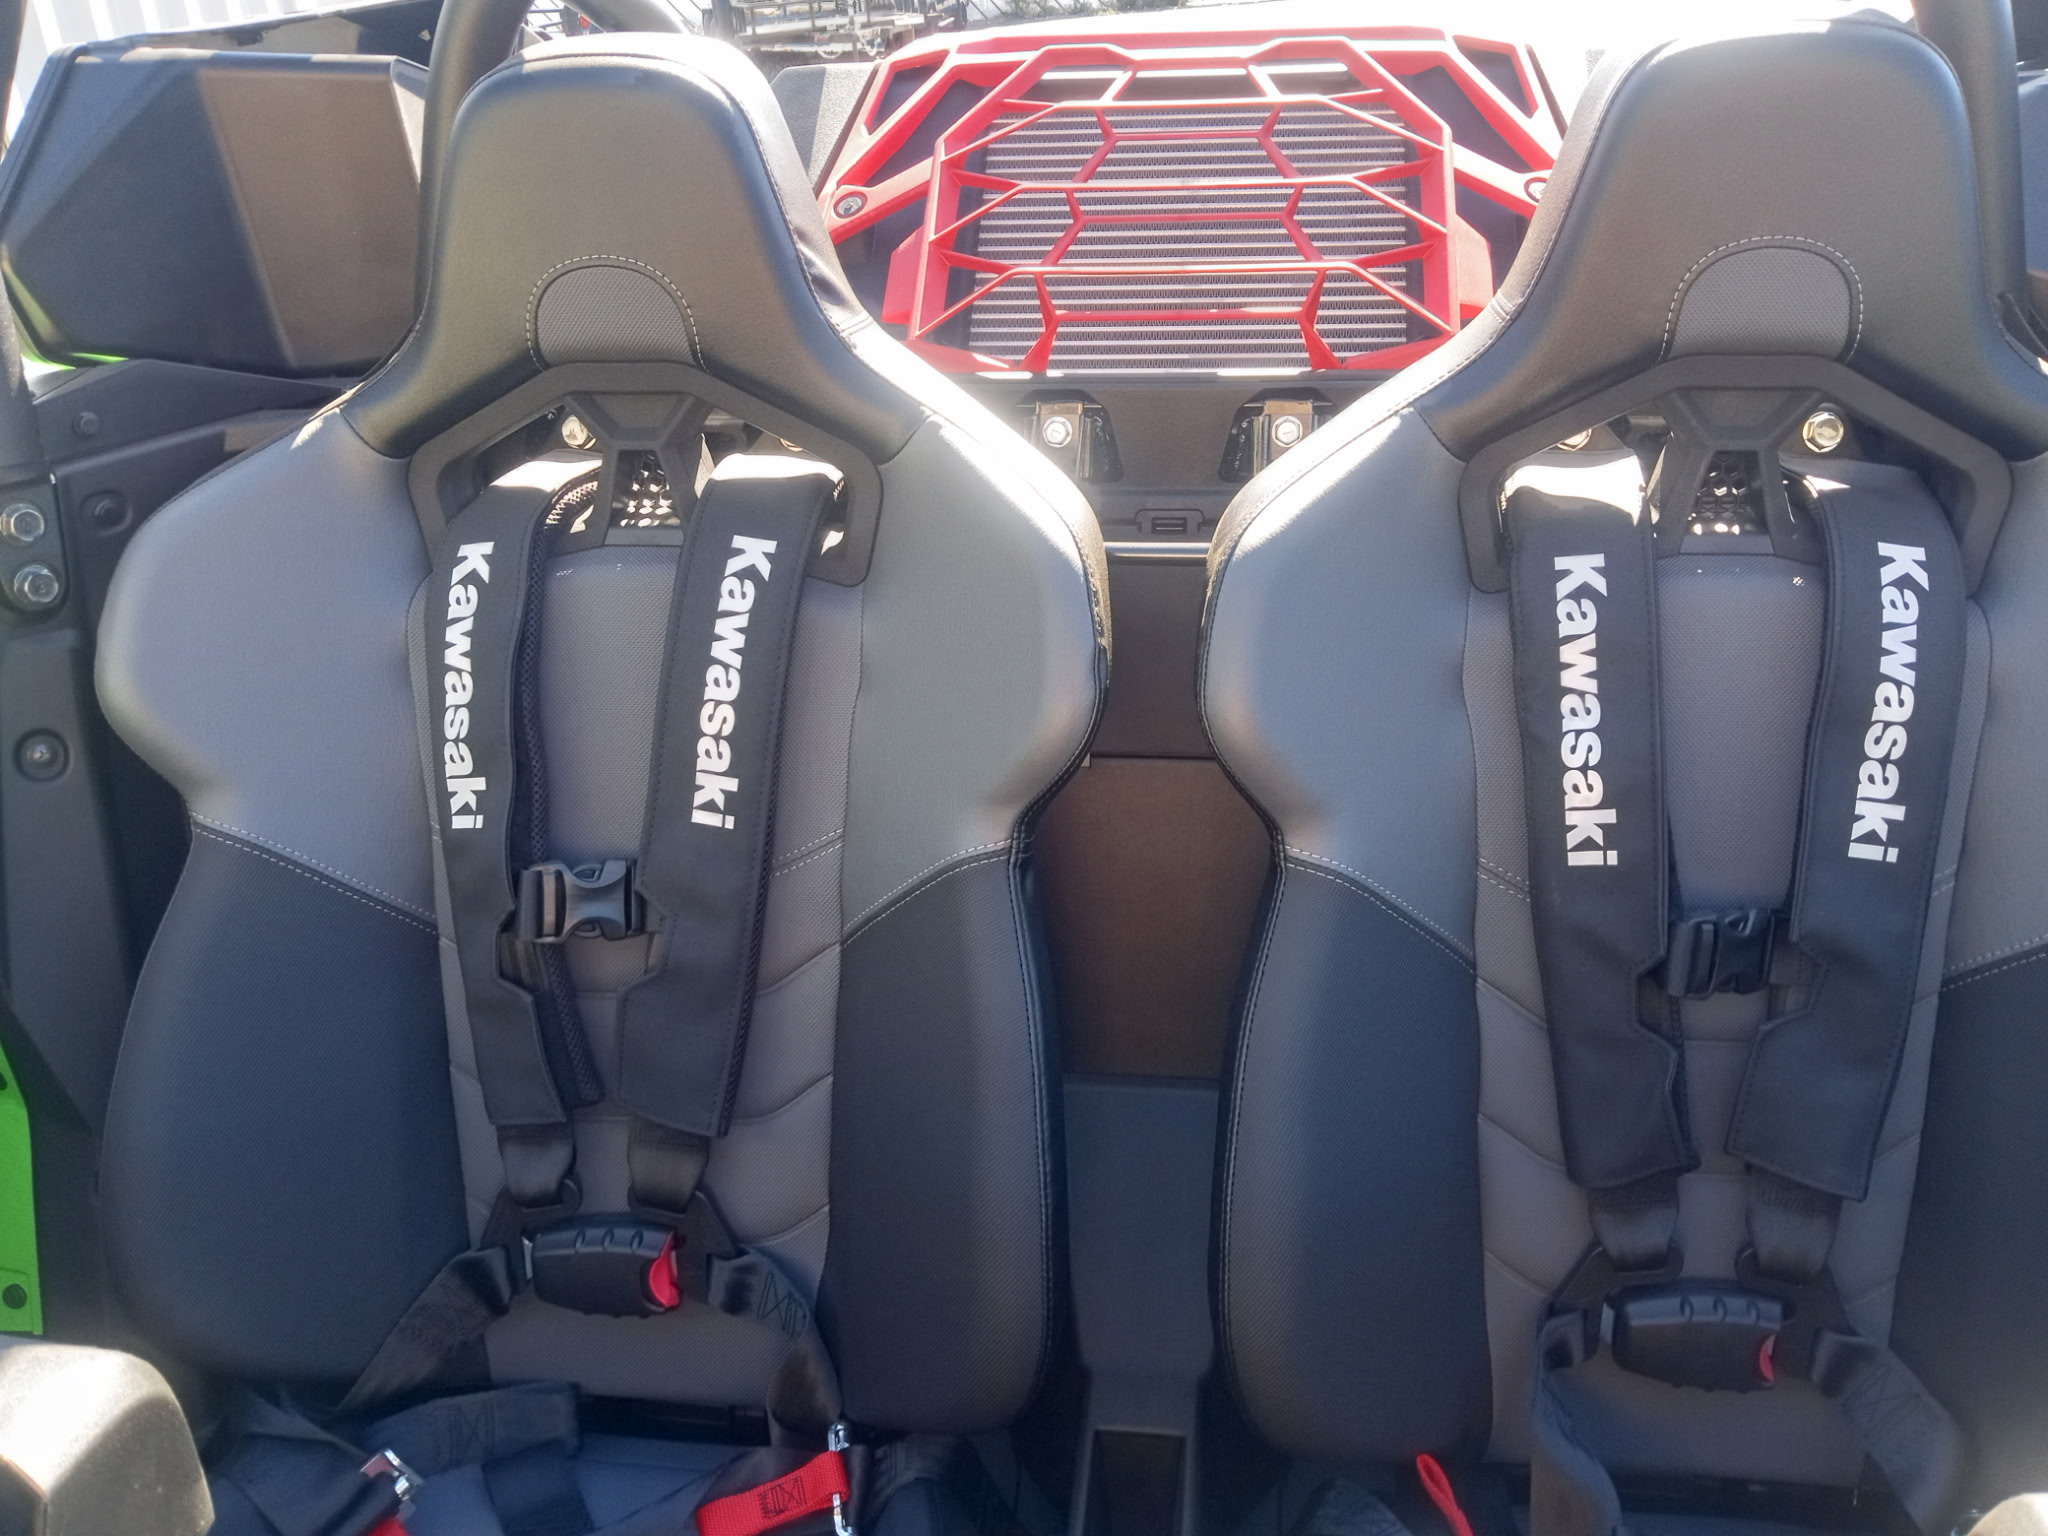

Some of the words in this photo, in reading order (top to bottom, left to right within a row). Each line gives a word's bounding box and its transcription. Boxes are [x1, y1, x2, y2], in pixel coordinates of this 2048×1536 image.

[444, 541, 495, 829] Kawasaki
[691, 535, 778, 829] Kawasaki
[1554, 553, 1617, 866] Kawasaki
[1848, 542, 1929, 863] Kawasaki
